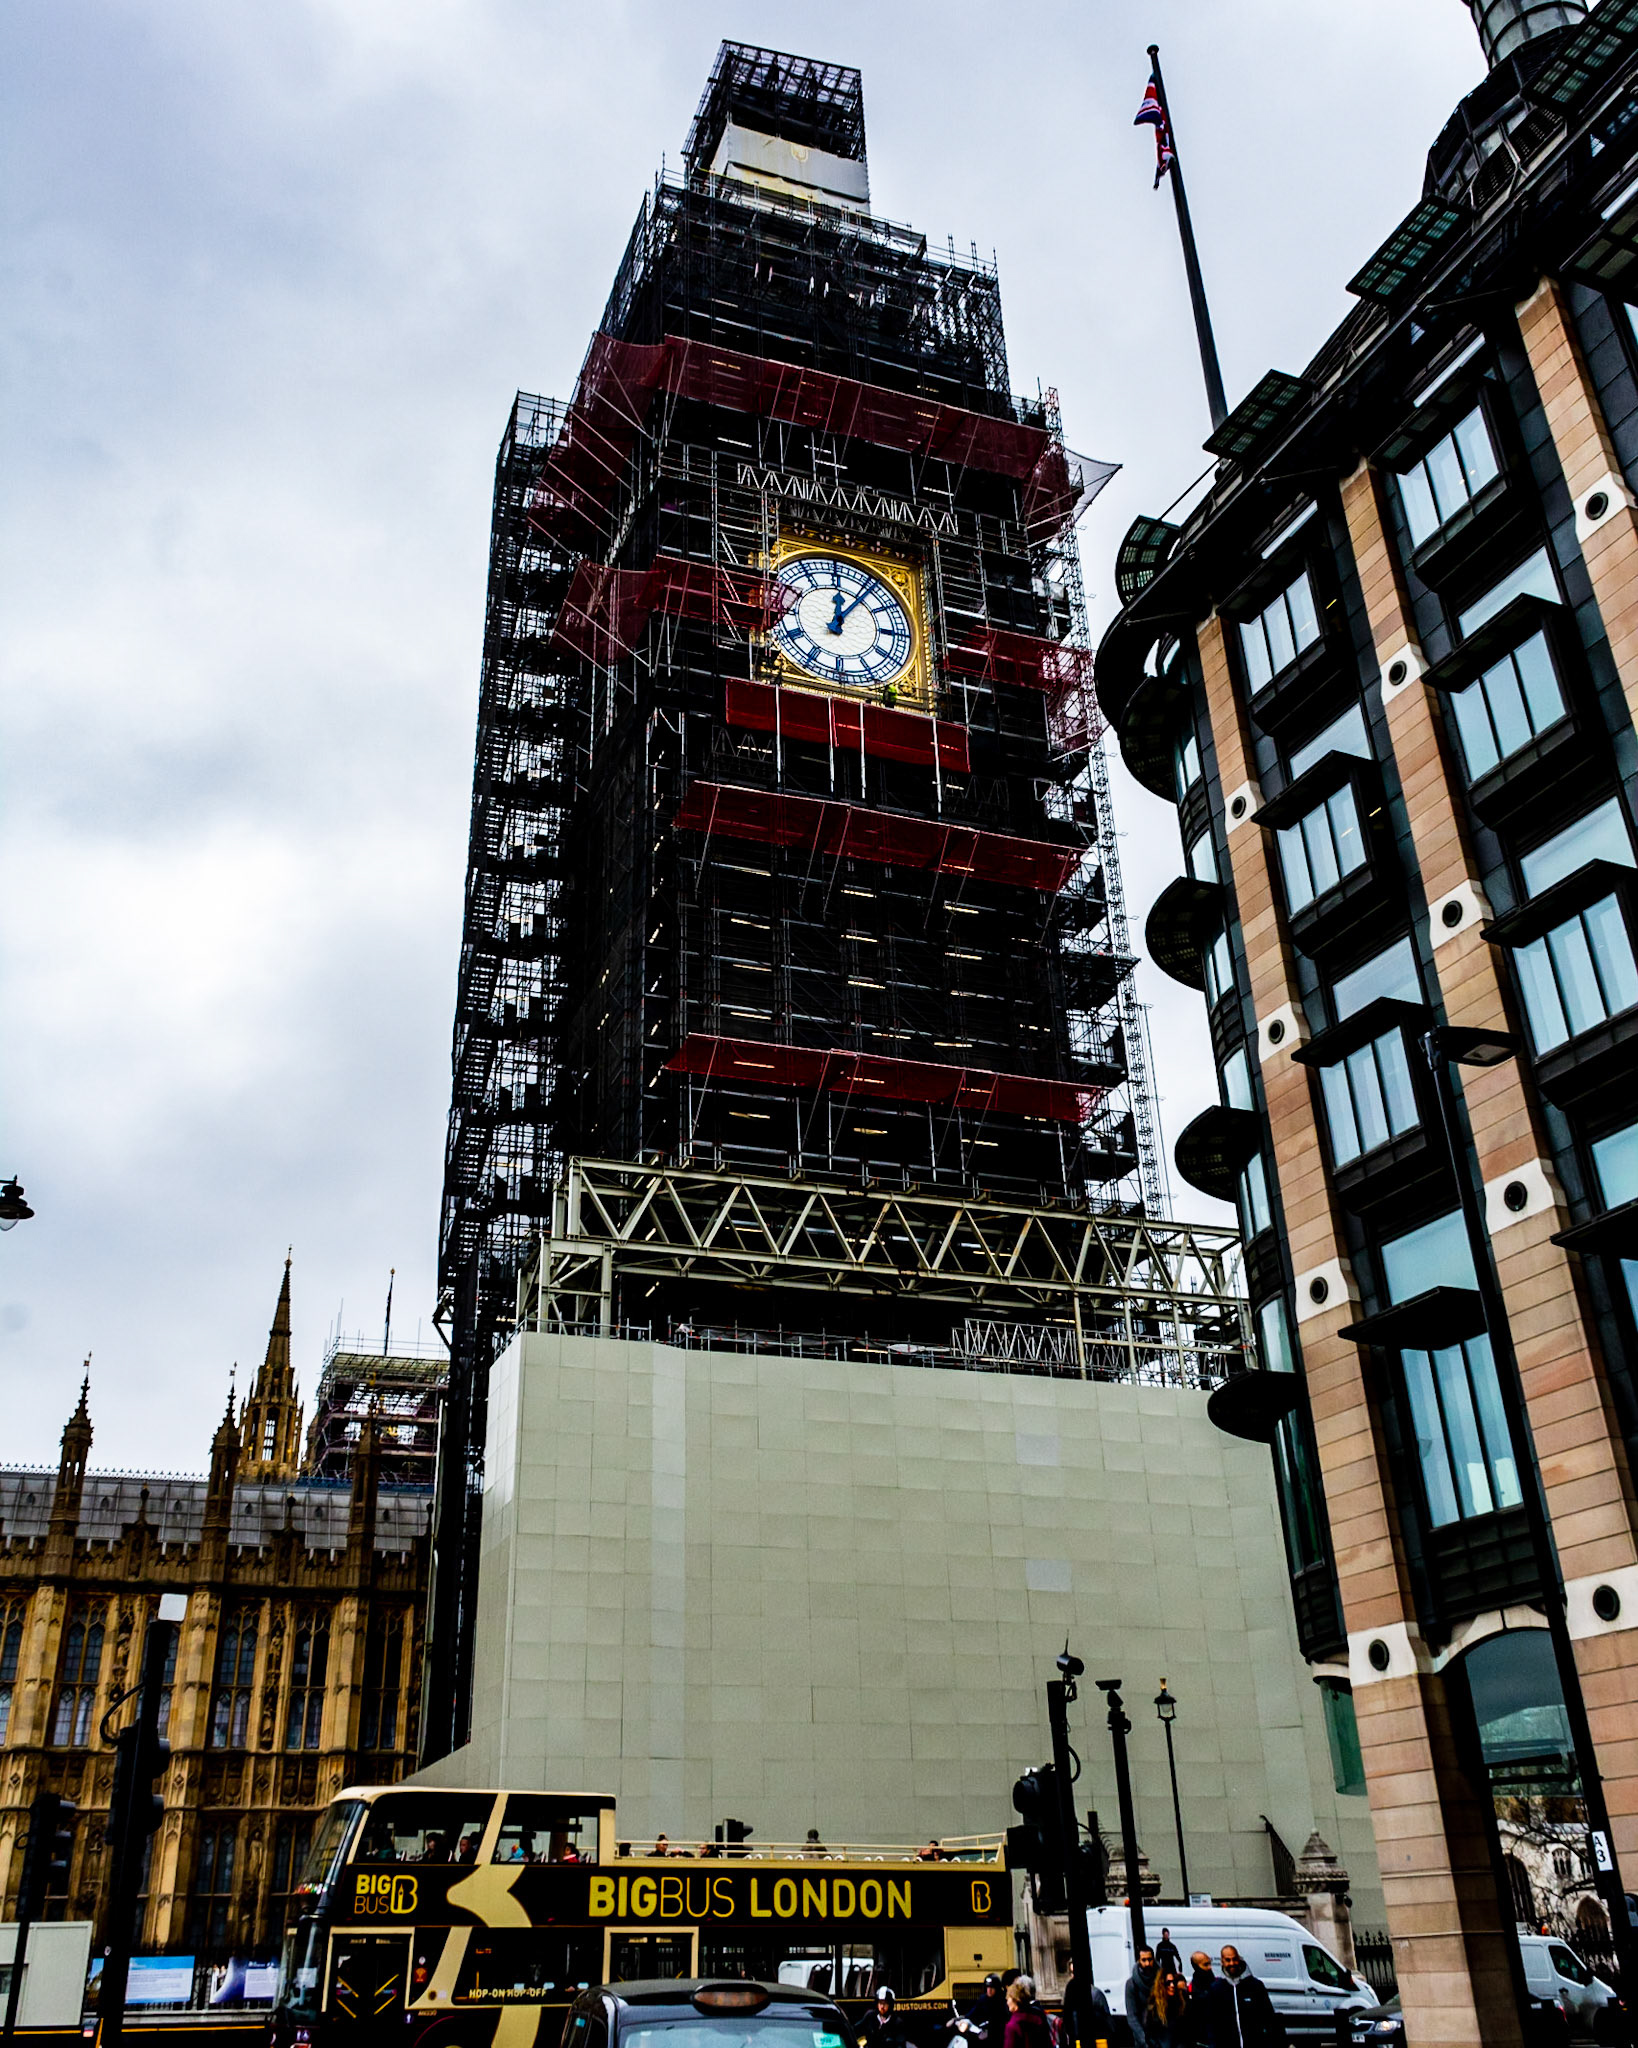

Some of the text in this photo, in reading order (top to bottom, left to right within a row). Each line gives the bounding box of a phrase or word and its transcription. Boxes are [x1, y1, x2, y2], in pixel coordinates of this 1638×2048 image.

[1597, 1849, 1606, 1862] 3
[356, 1874, 391, 1894] BIG
[354, 1895, 389, 1914] BUS
[751, 1877, 911, 1918] LONDON
